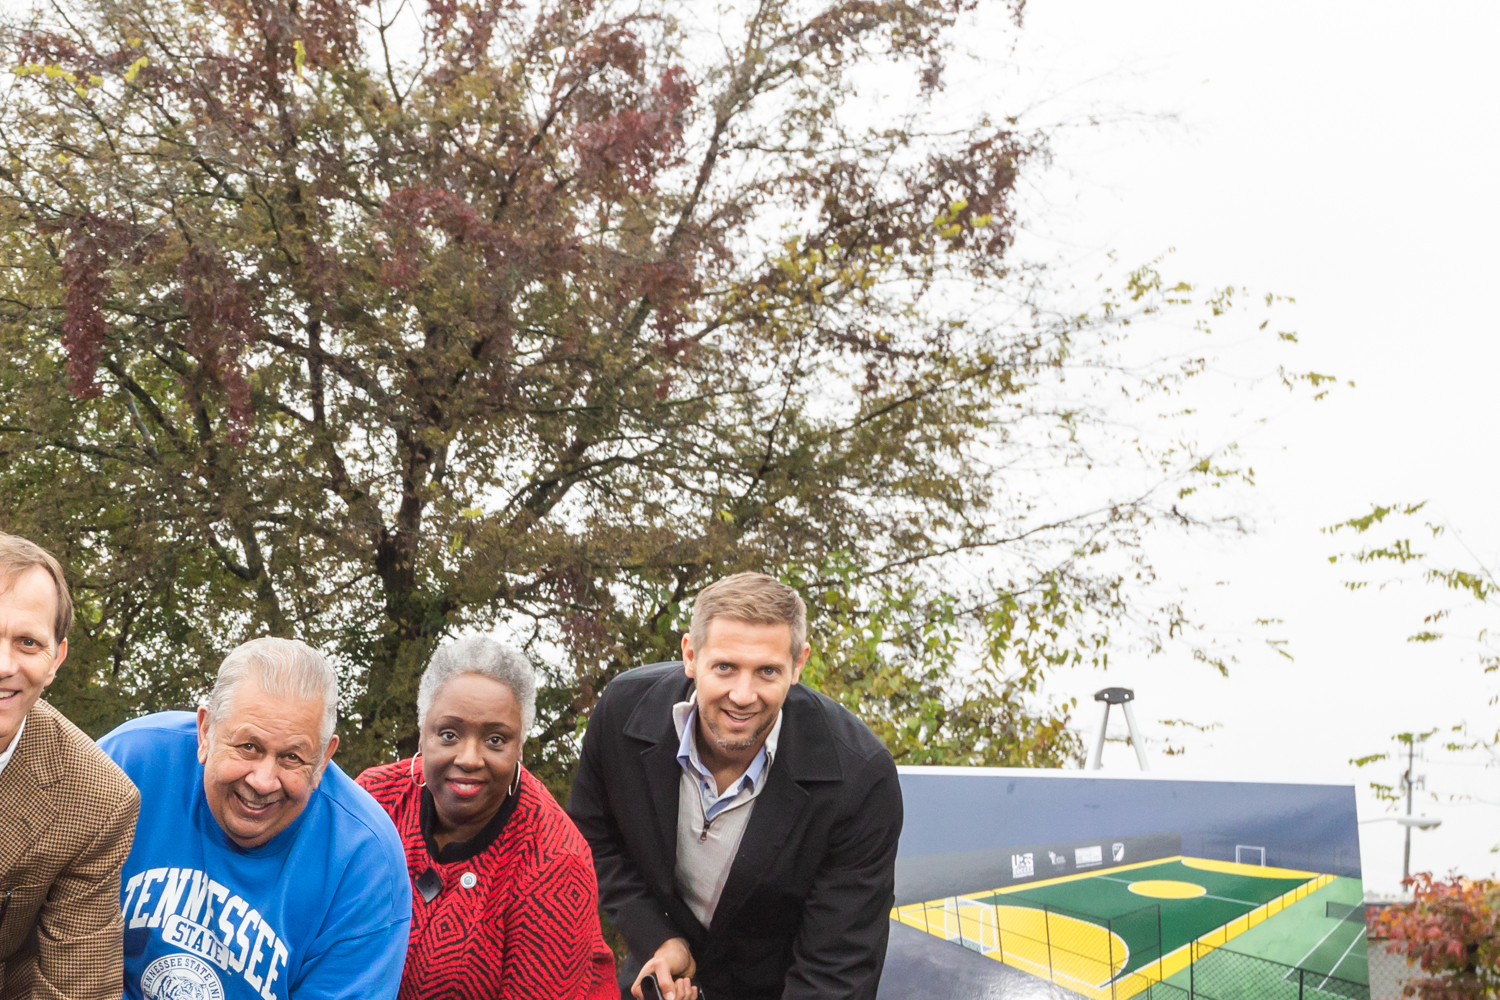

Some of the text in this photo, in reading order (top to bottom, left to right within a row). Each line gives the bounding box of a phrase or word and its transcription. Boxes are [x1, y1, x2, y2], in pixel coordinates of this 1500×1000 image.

[172, 921, 223, 967] STATE
[143, 958, 183, 994] TENNESSEE
[185, 958, 213, 981] STATE
